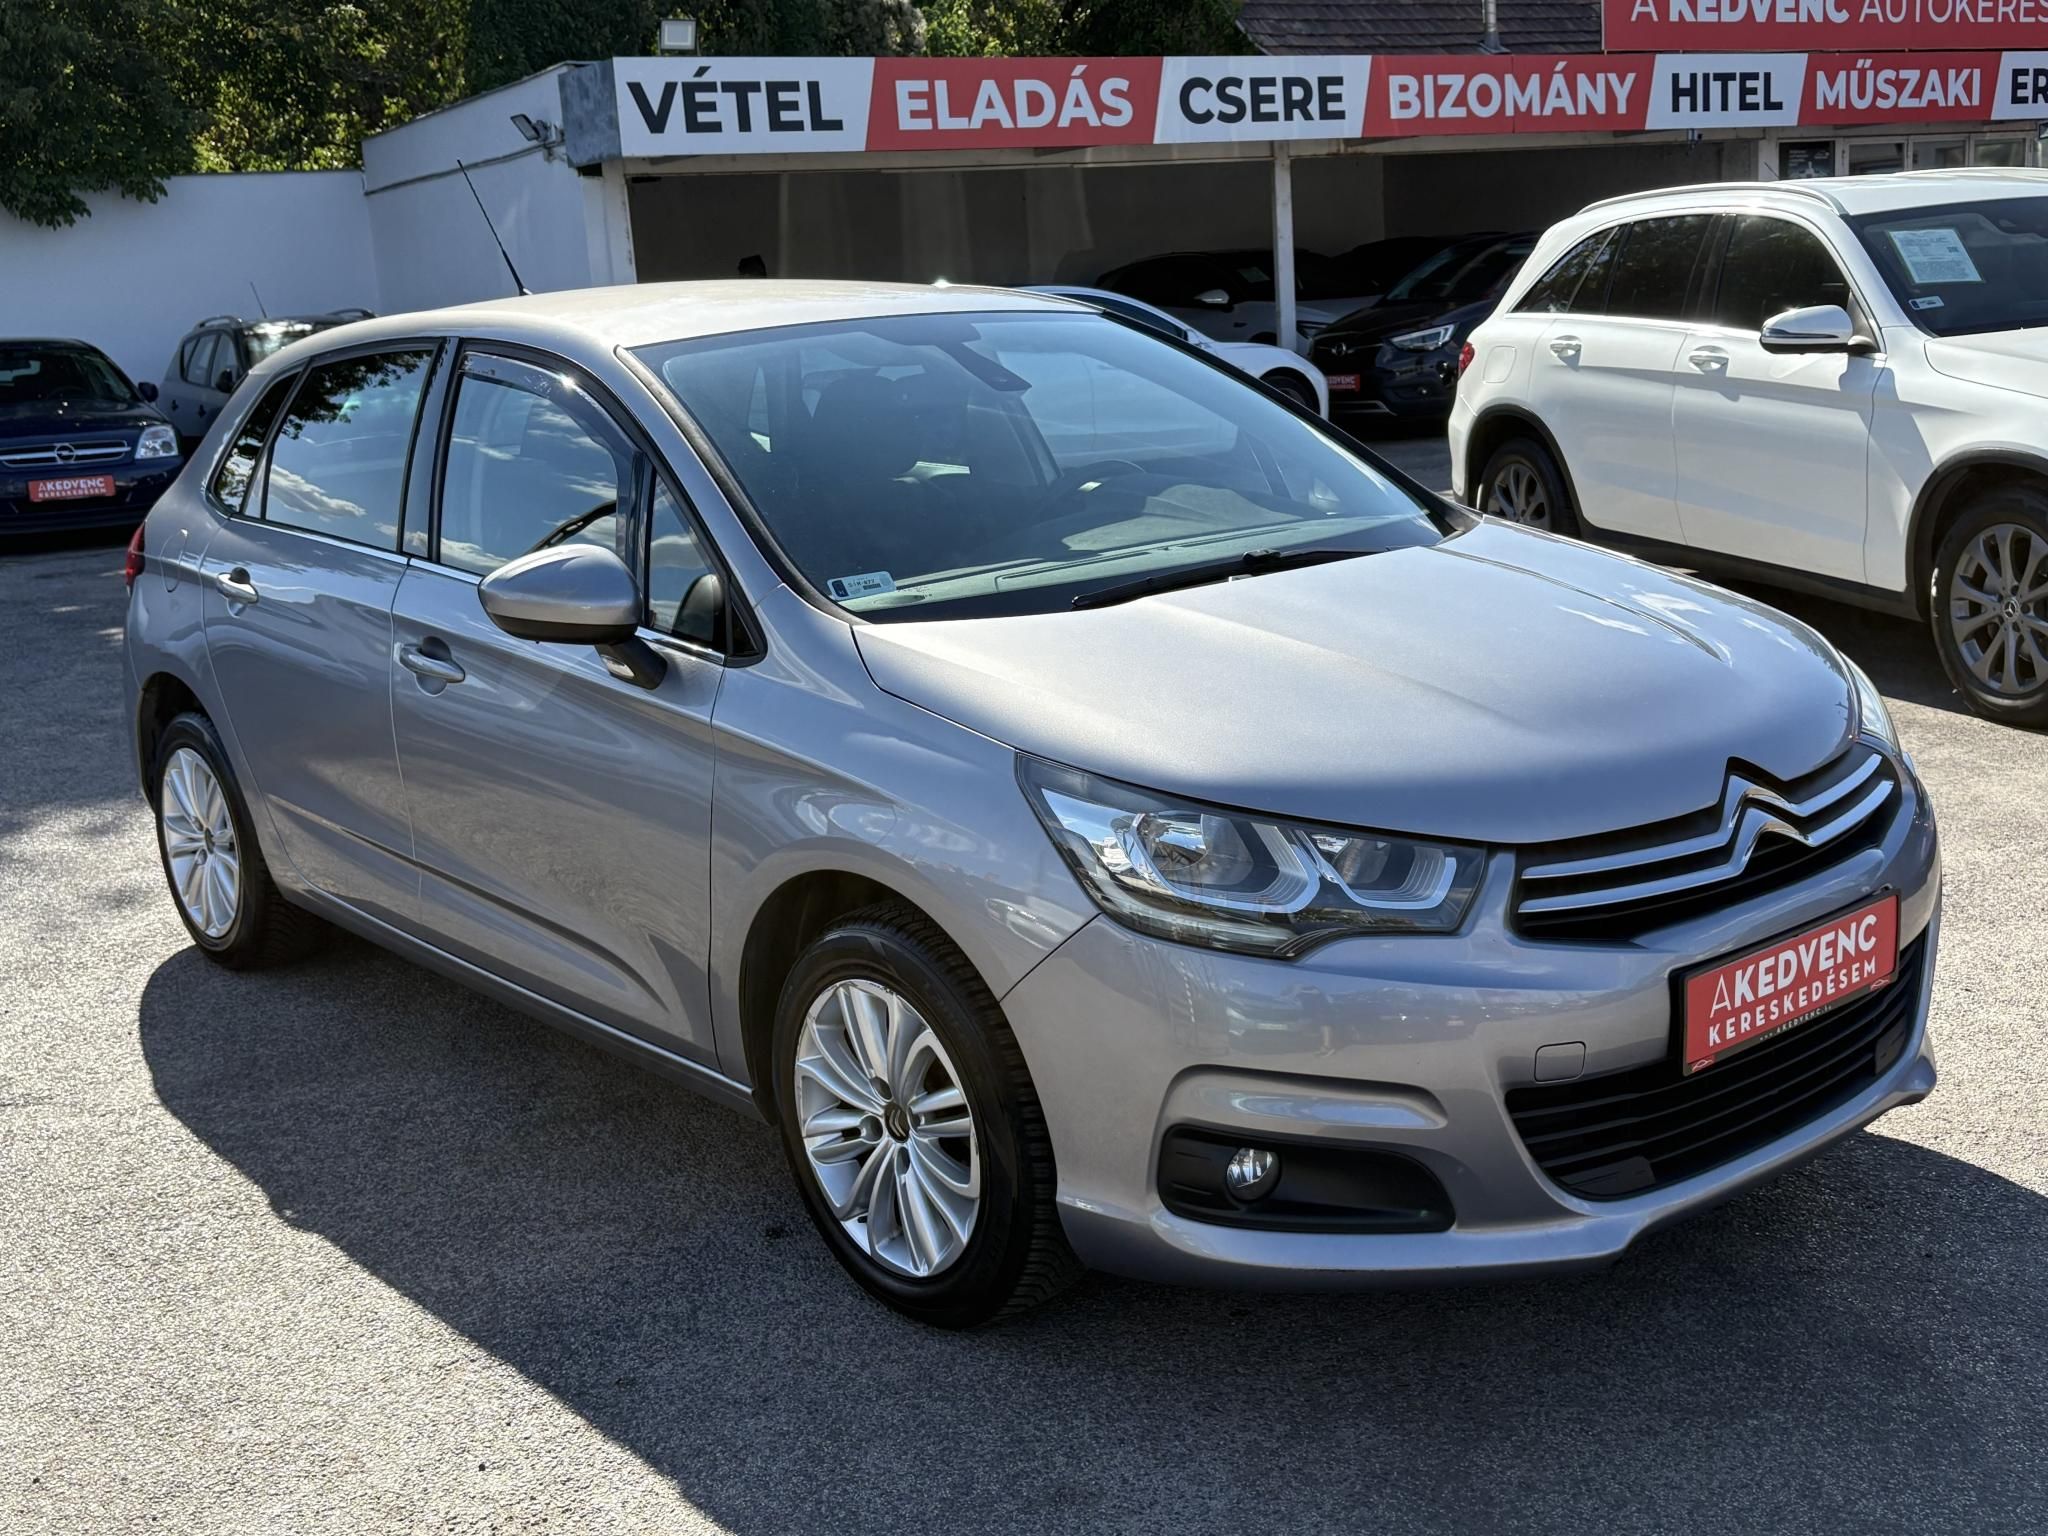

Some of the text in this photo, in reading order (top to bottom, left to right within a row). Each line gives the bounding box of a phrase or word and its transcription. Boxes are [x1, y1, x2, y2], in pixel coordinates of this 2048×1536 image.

[1631, 0, 1658, 23] A
[1668, 0, 1850, 24] KEDVENC
[626, 66, 844, 135] VÉTEL
[895, 65, 1133, 131] ELADÁS
[1179, 75, 1346, 124] CSERE
[1389, 61, 1637, 120] BIZOMÁNY
[1671, 71, 1783, 113] HITEL
[1816, 58, 1981, 110] MŰSZAKI
[1708, 956, 1877, 1047] KERESKEDÉSEM
